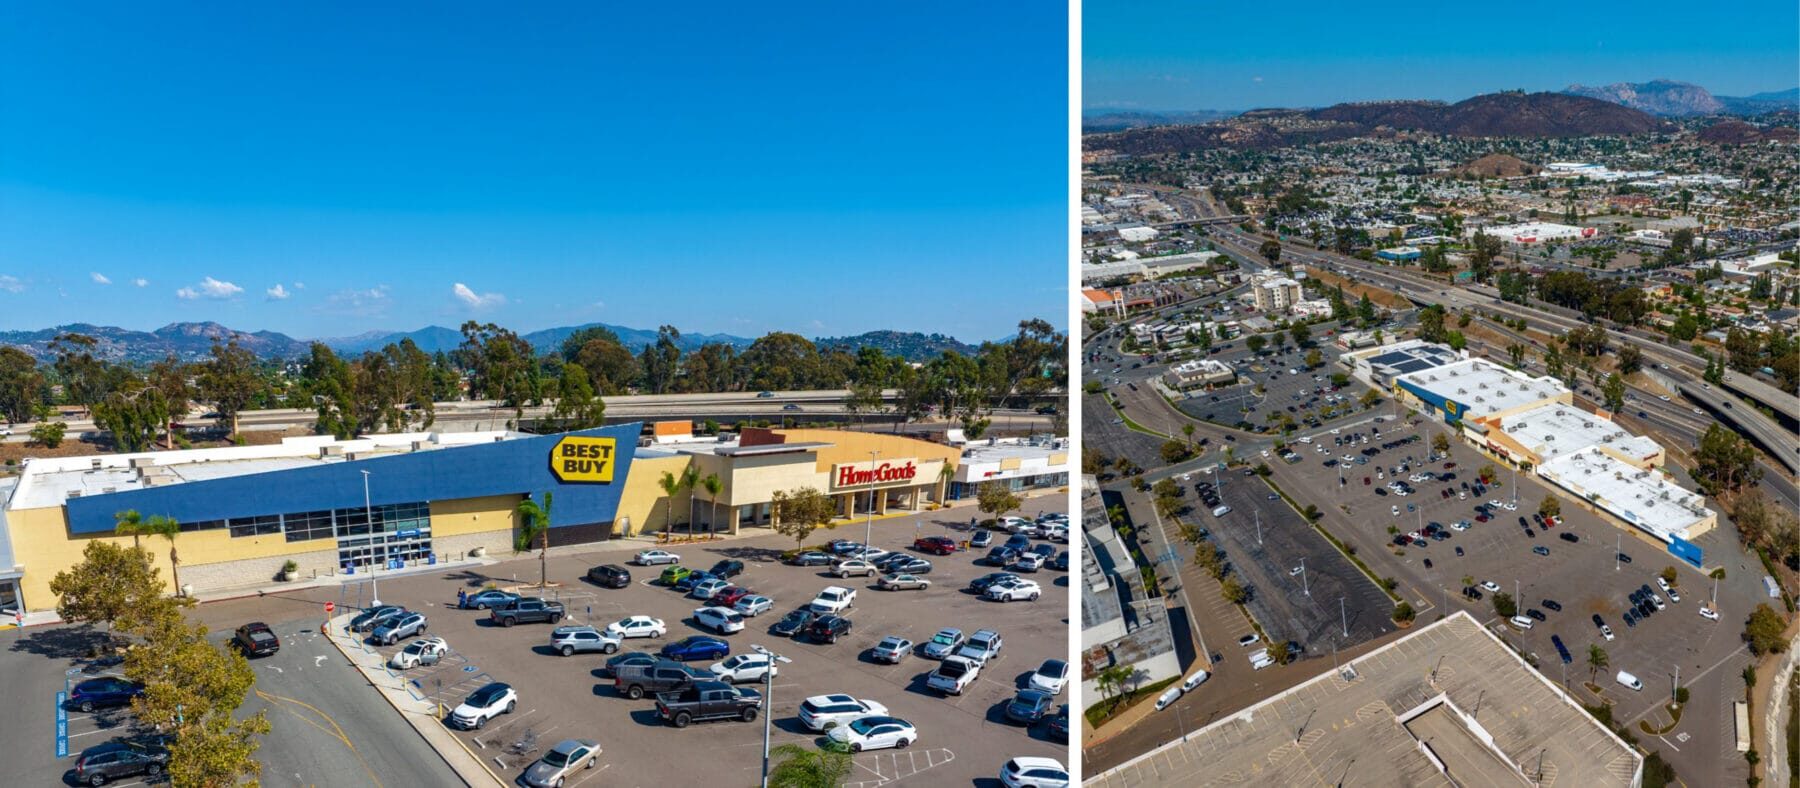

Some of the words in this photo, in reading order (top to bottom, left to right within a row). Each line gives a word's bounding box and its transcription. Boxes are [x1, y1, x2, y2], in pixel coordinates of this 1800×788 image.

[562, 443, 612, 458] BEST
[563, 460, 607, 473] BUY
[838, 461, 916, 486] HomeGoods
